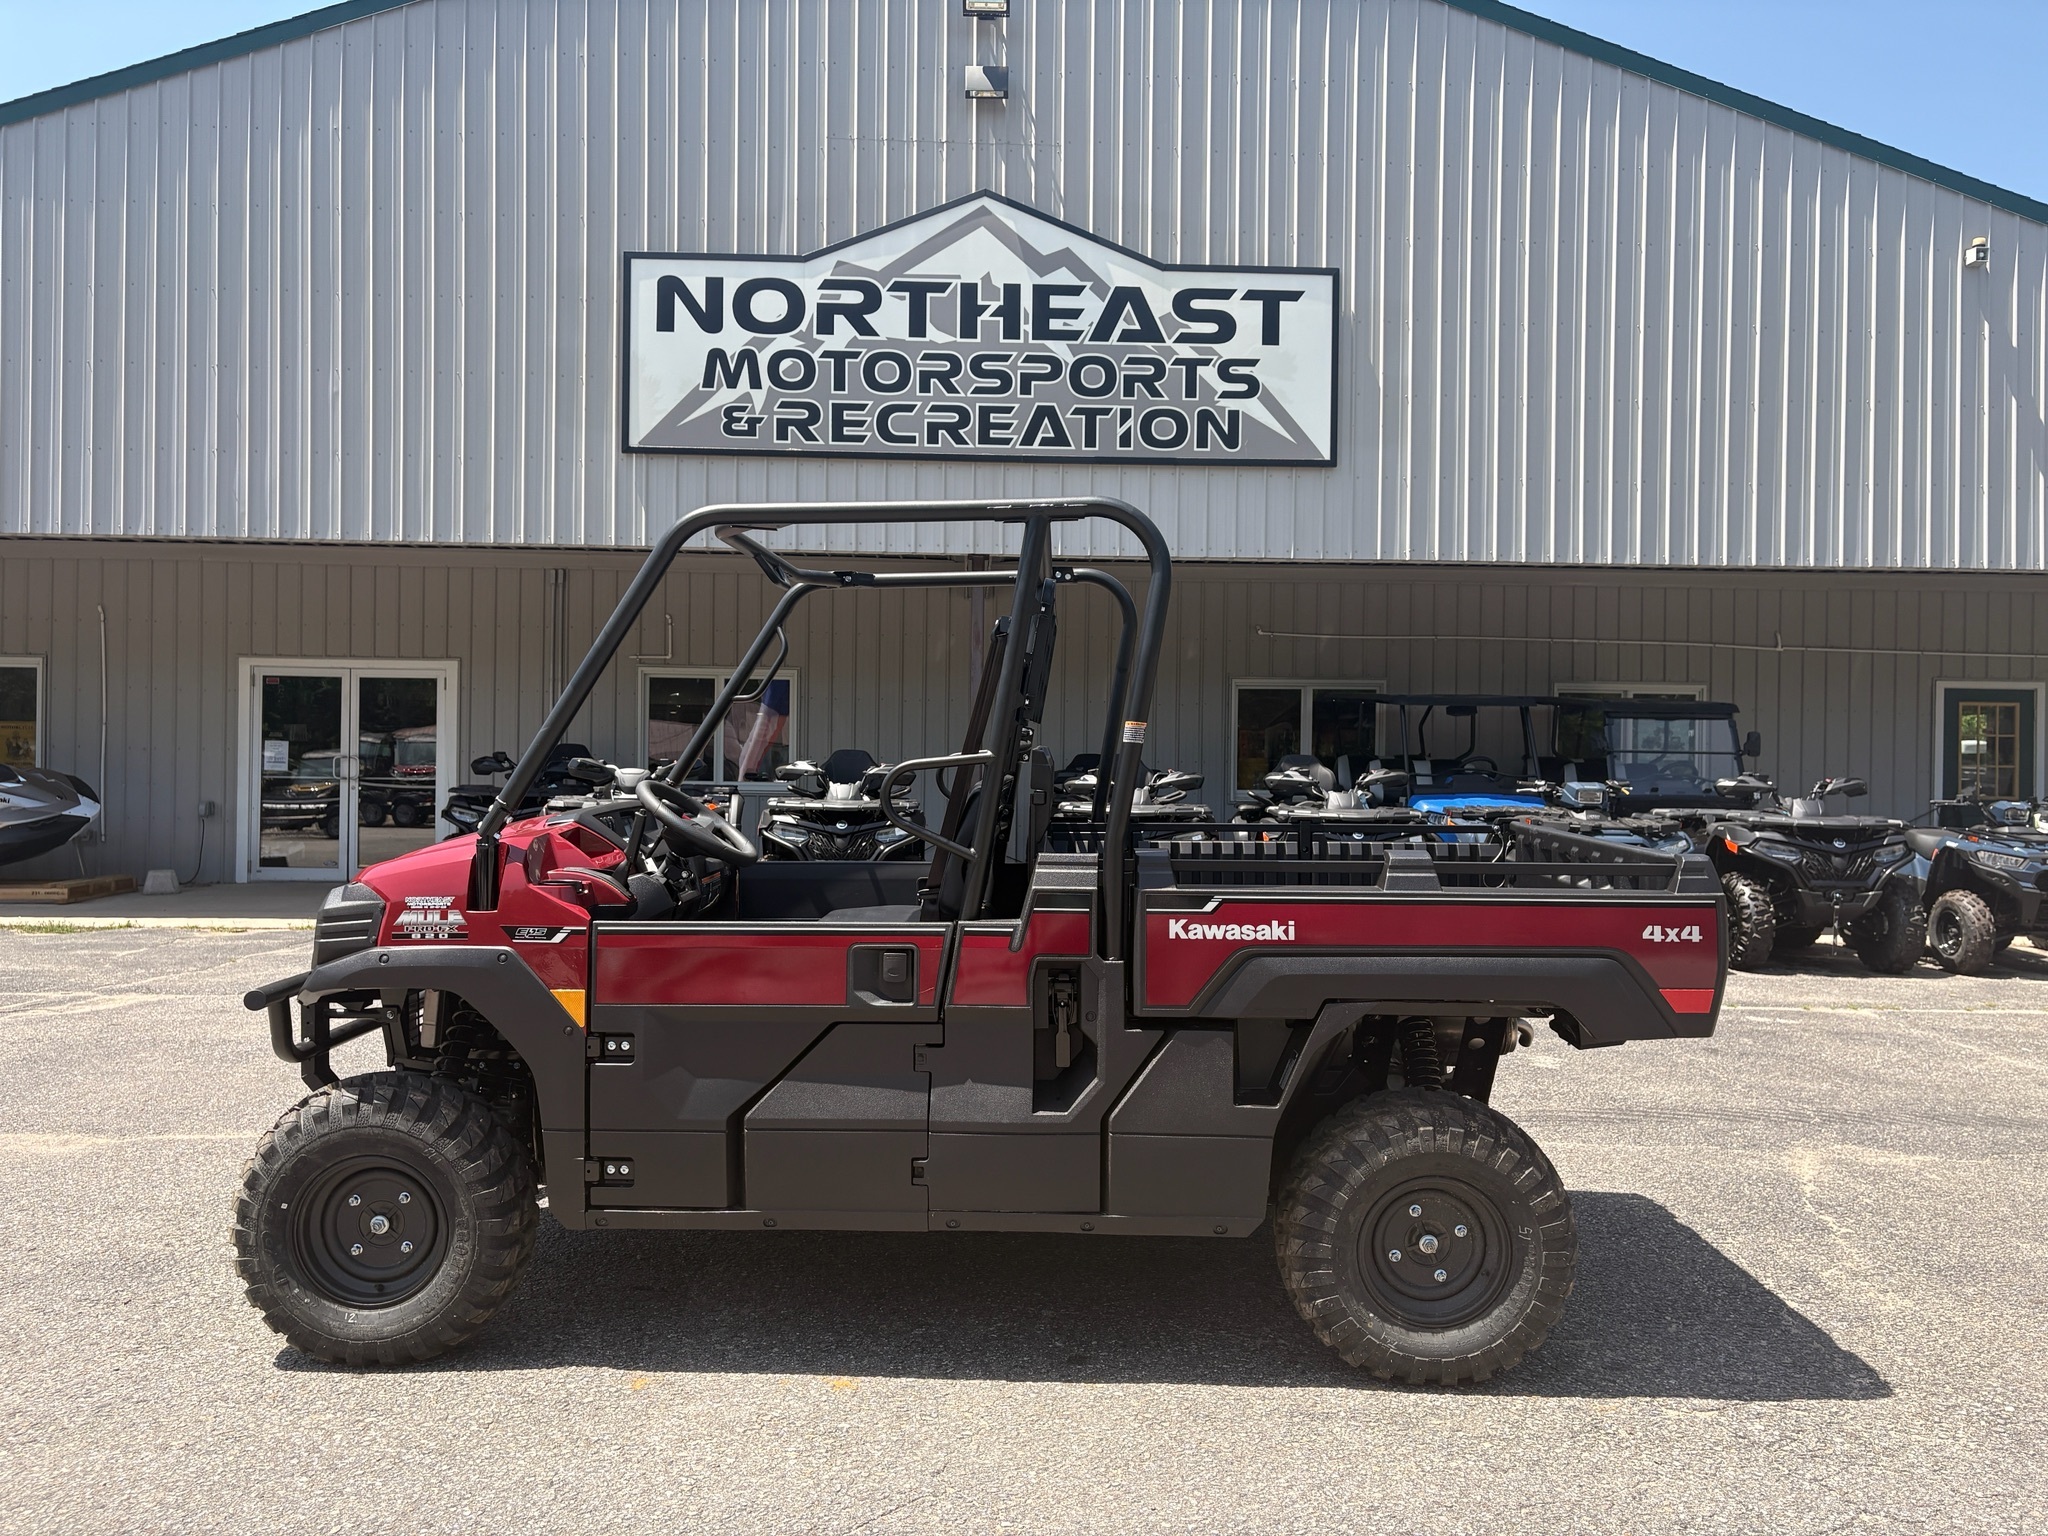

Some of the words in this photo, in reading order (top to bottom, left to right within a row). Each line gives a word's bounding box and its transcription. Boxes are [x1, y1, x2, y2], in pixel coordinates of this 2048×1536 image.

[656, 275, 1306, 346] NORTHEAST
[701, 347, 1261, 400] MOTORSPORTS
[393, 909, 468, 925] MULE
[1168, 918, 1296, 941] Kawasaki
[1642, 925, 1704, 943] 4x4
